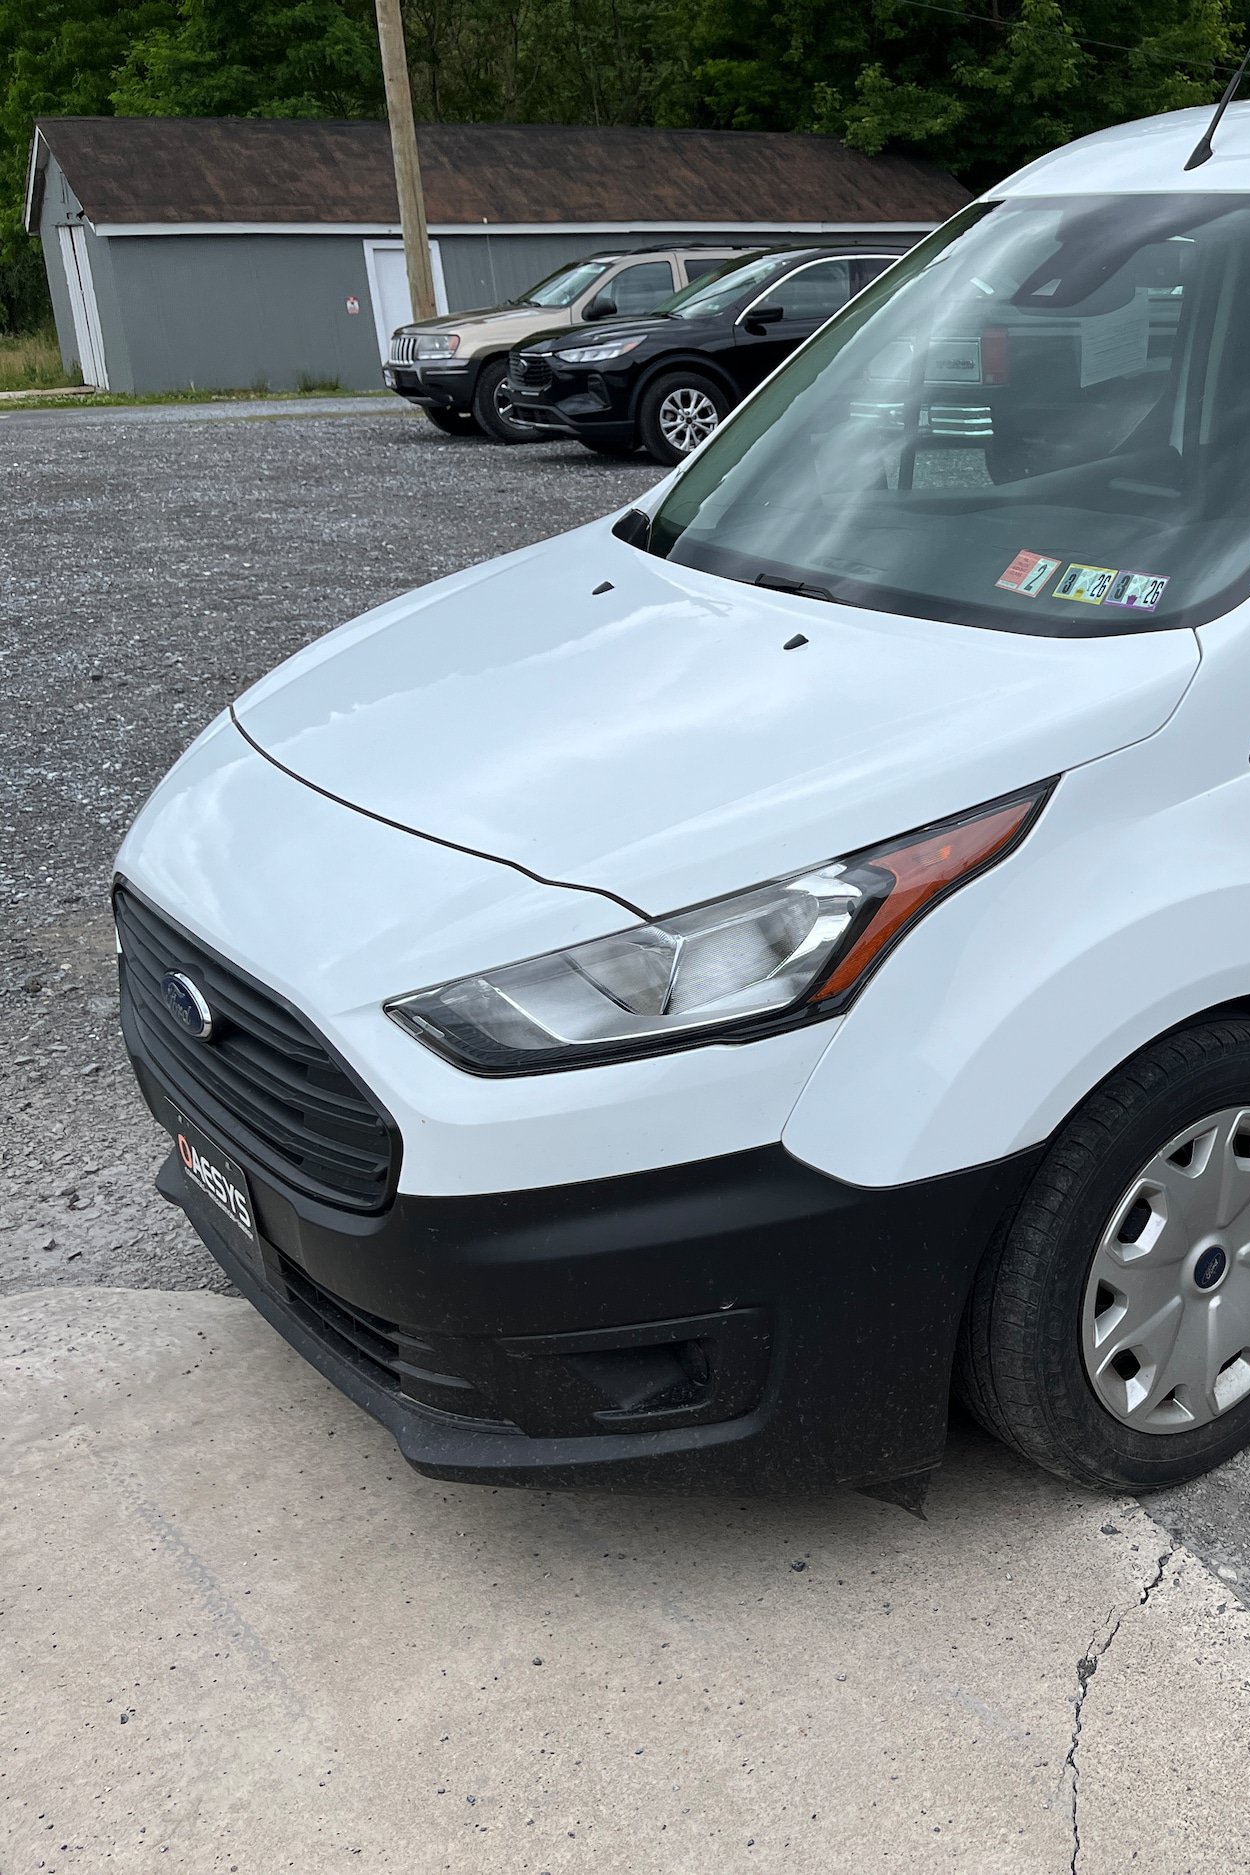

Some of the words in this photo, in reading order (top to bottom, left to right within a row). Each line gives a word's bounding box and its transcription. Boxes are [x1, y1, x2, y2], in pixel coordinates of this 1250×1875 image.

[1089, 573, 1112, 598] 26
[1142, 579, 1165, 605] 26
[166, 981, 193, 1026] Ford
[178, 1133, 251, 1228] OAESYS
